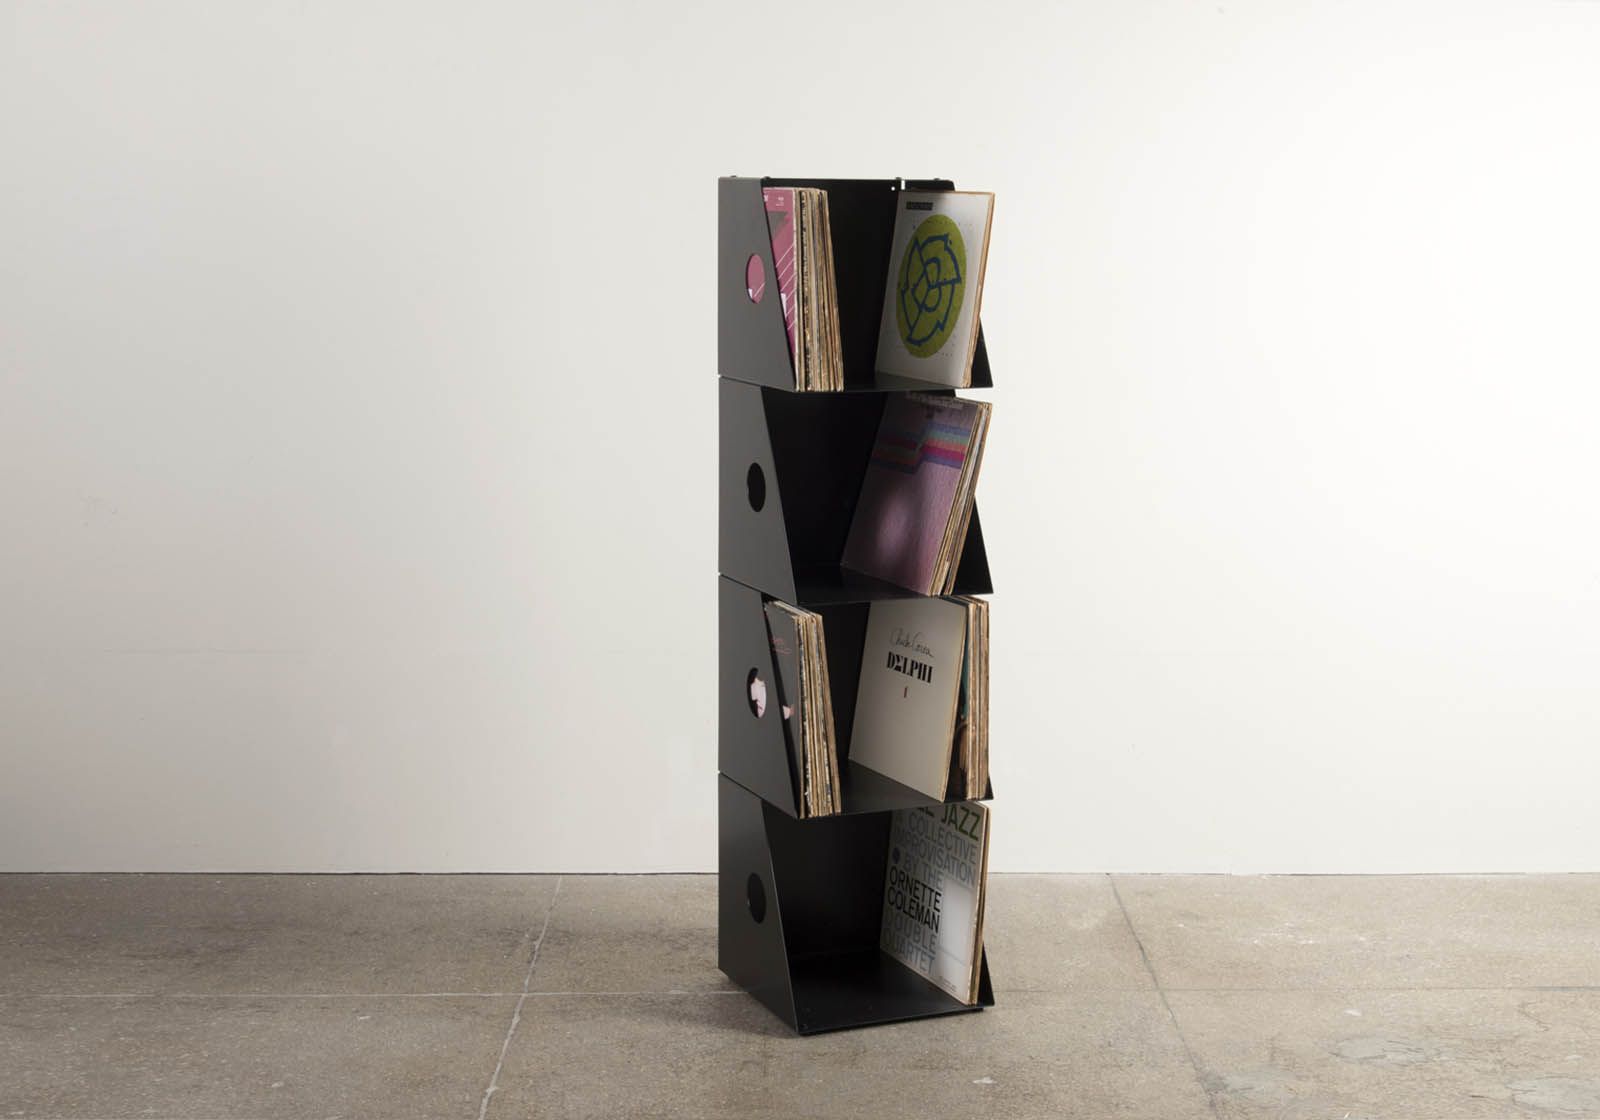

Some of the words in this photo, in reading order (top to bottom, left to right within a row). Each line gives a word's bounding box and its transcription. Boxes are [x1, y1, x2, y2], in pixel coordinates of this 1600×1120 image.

[887, 651, 933, 683] DELPHI
[908, 811, 978, 865] COLLECTIVE
[940, 804, 980, 842] JAZZ
[889, 865, 942, 913] ORNETTE
[903, 852, 920, 876] BY
[921, 860, 944, 891] THE
[883, 905, 937, 955] DOUBLE
[887, 886, 940, 934] COLEMAN
[881, 926, 937, 975] QUARTET
